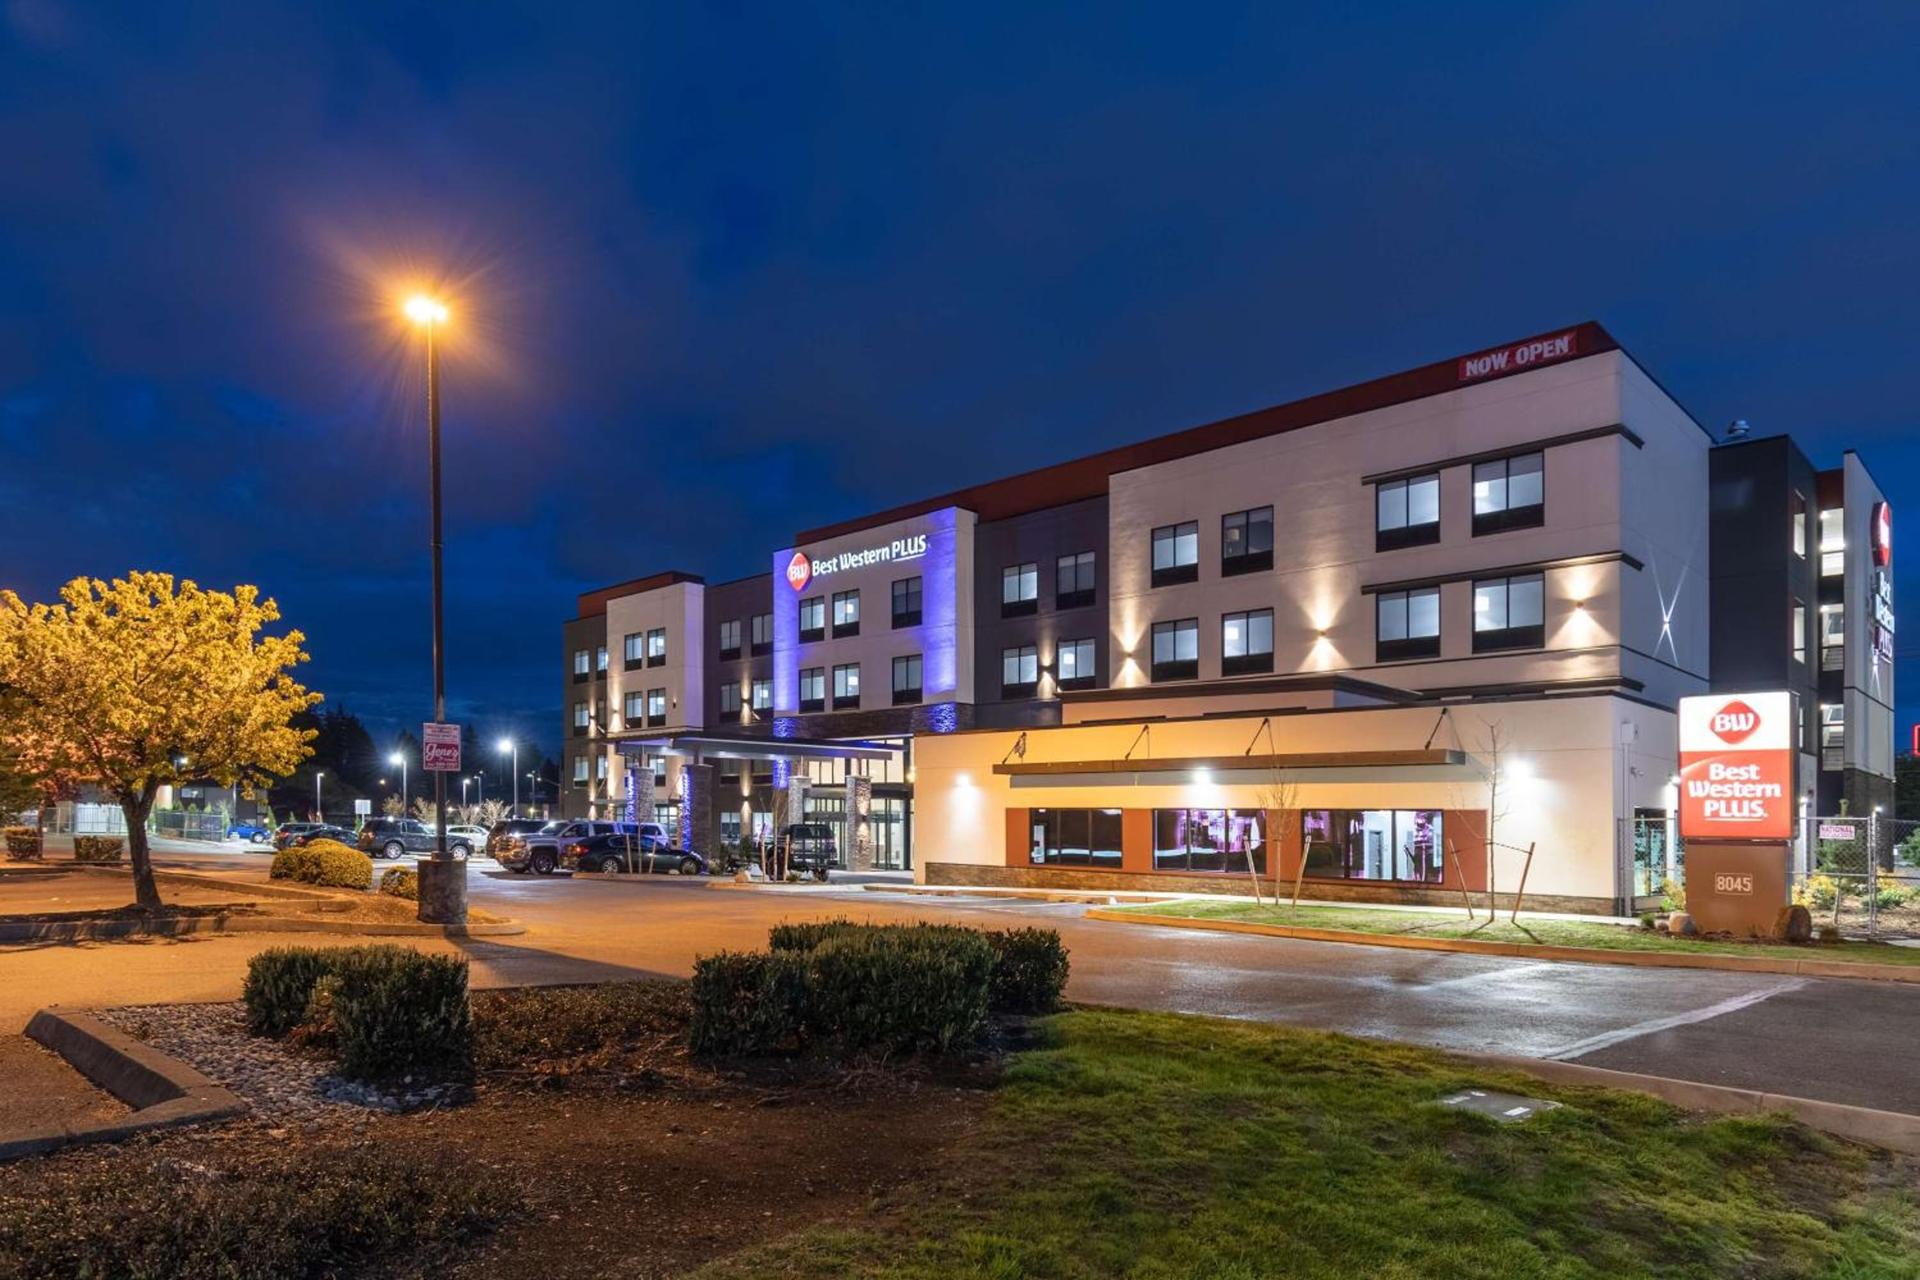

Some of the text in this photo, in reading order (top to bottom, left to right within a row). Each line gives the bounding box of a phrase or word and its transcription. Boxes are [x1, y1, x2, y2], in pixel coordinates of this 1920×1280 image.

[1465, 336, 1570, 377] NOW OPEN
[812, 535, 927, 577] Best Western PLUS
[1714, 712, 1756, 732] BW
[1709, 762, 1761, 780] Best
[1687, 780, 1782, 798] Western
[1717, 876, 1752, 892] 8045
